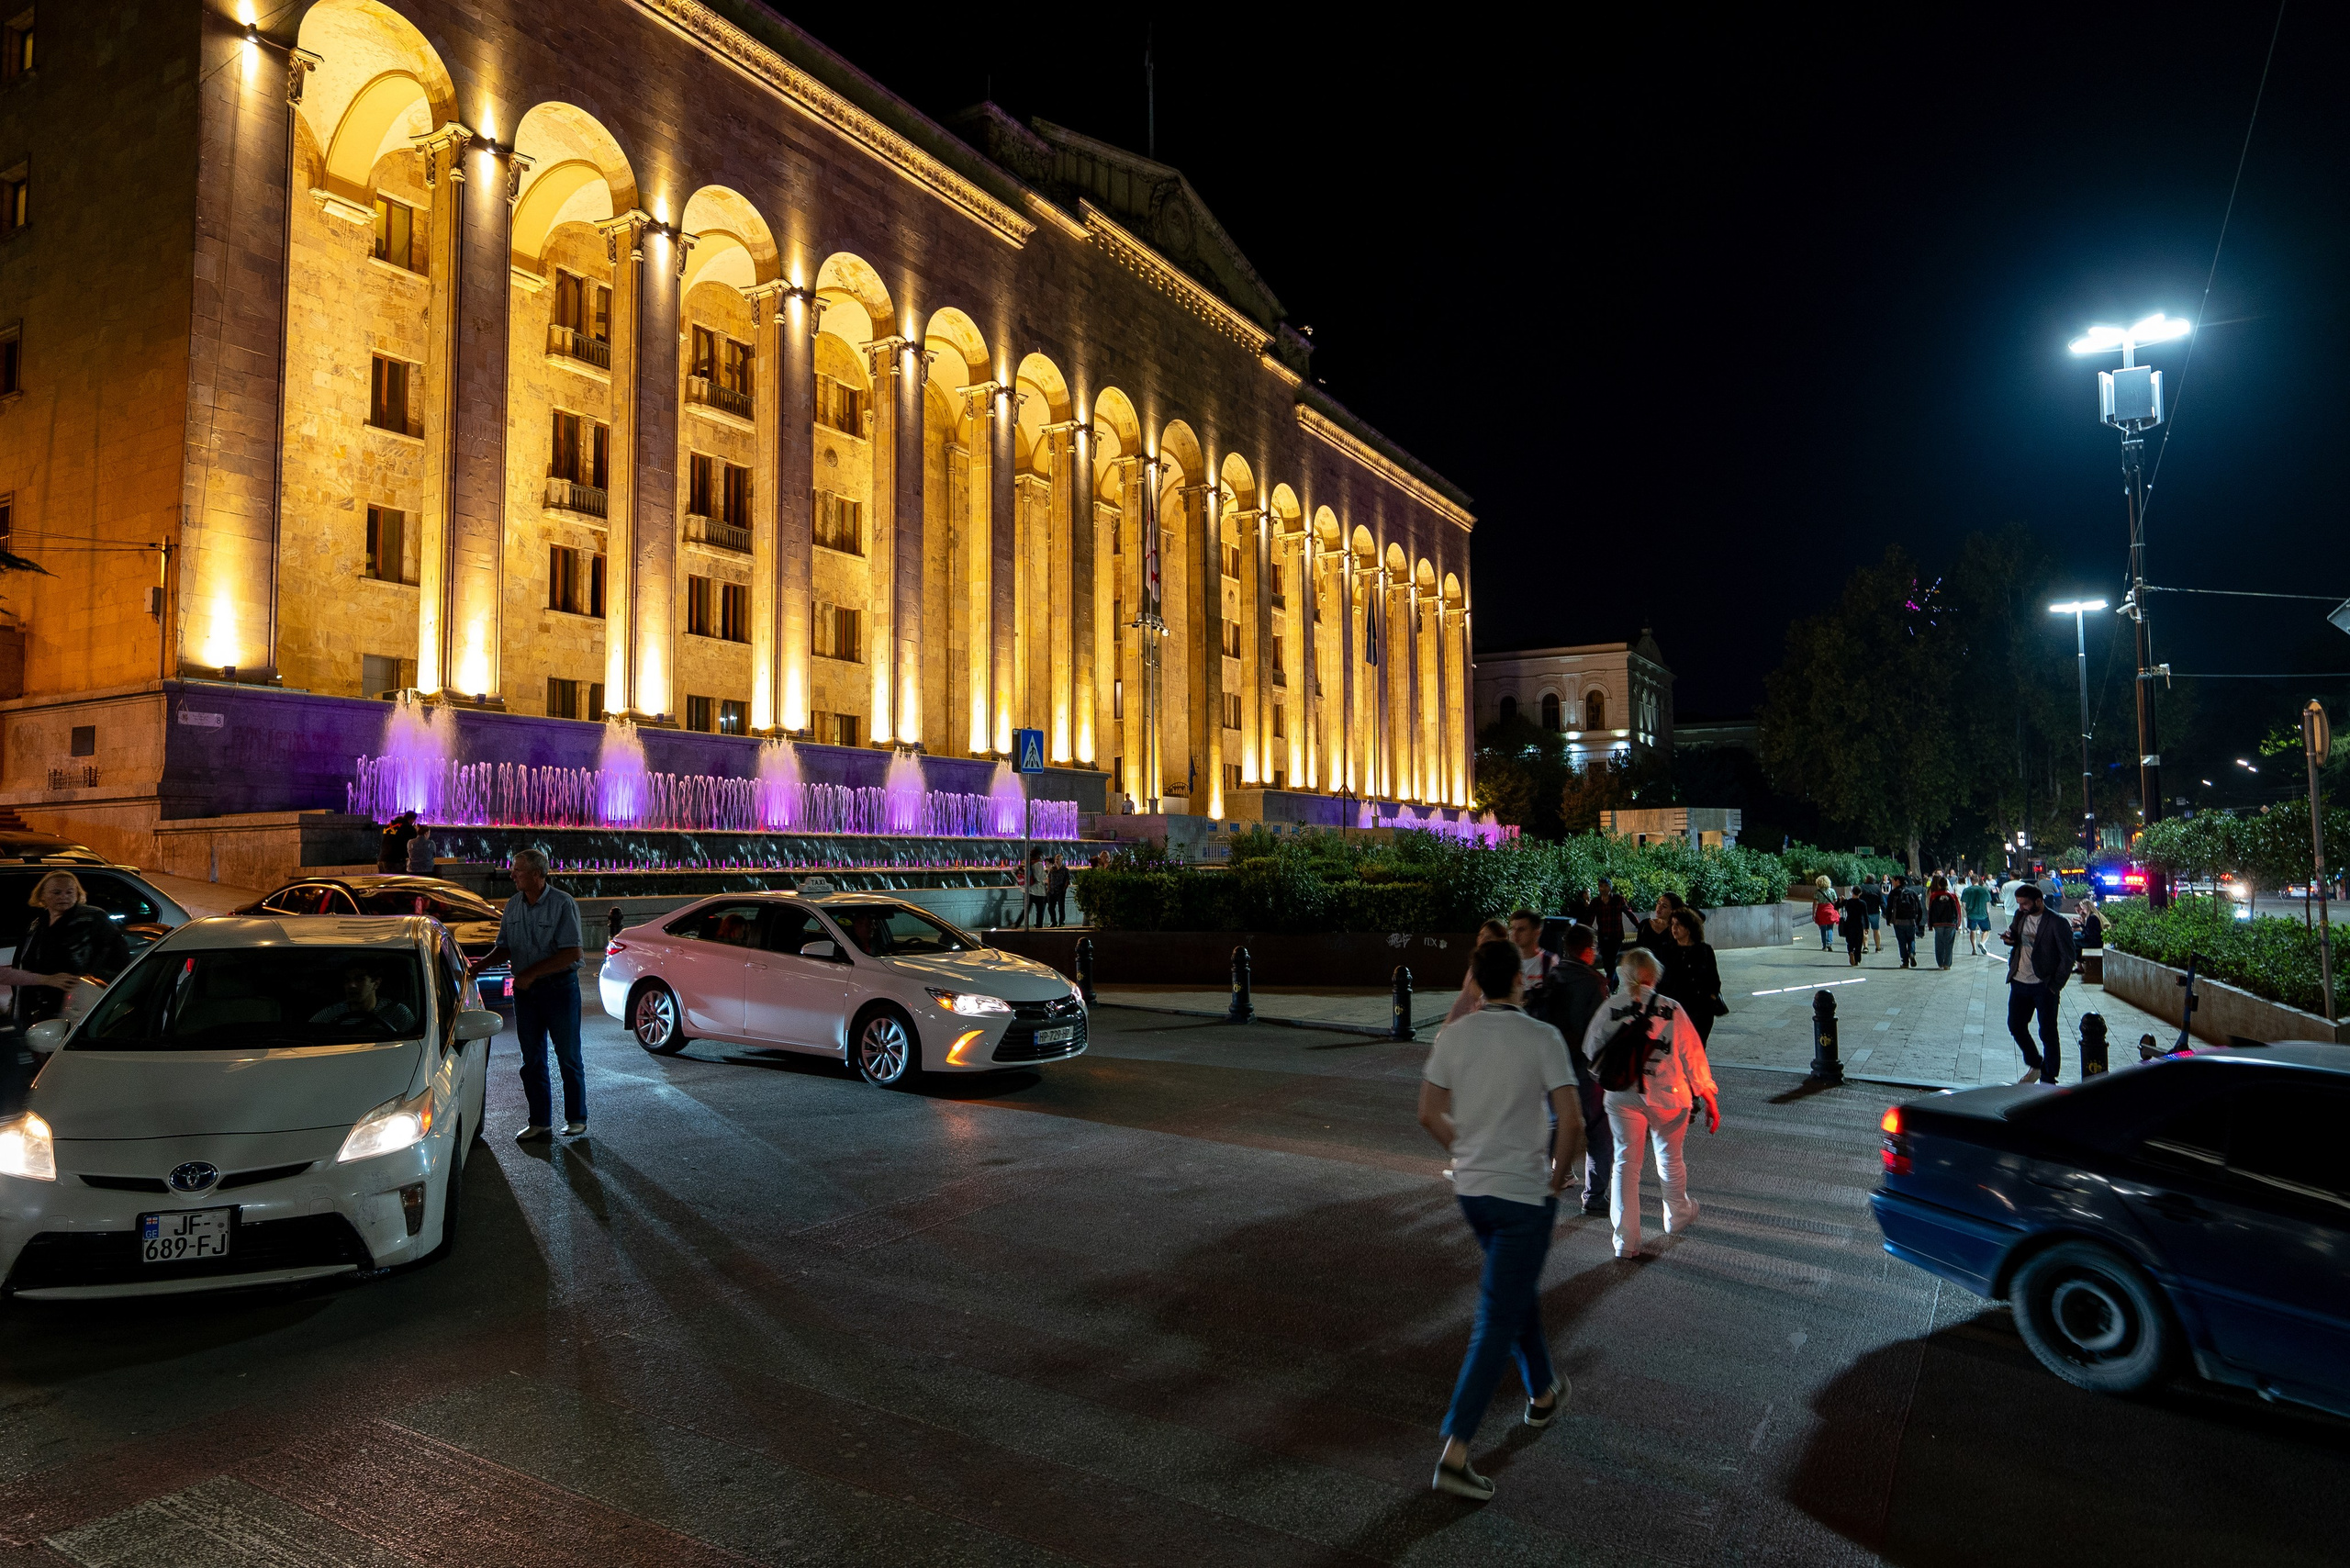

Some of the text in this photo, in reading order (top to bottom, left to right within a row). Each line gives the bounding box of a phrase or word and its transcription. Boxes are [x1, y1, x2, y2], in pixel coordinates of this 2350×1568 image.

[216, 716, 221, 724] 8
[146, 1229, 157, 1238] GE
[146, 1234, 226, 1260] 689-FJ
